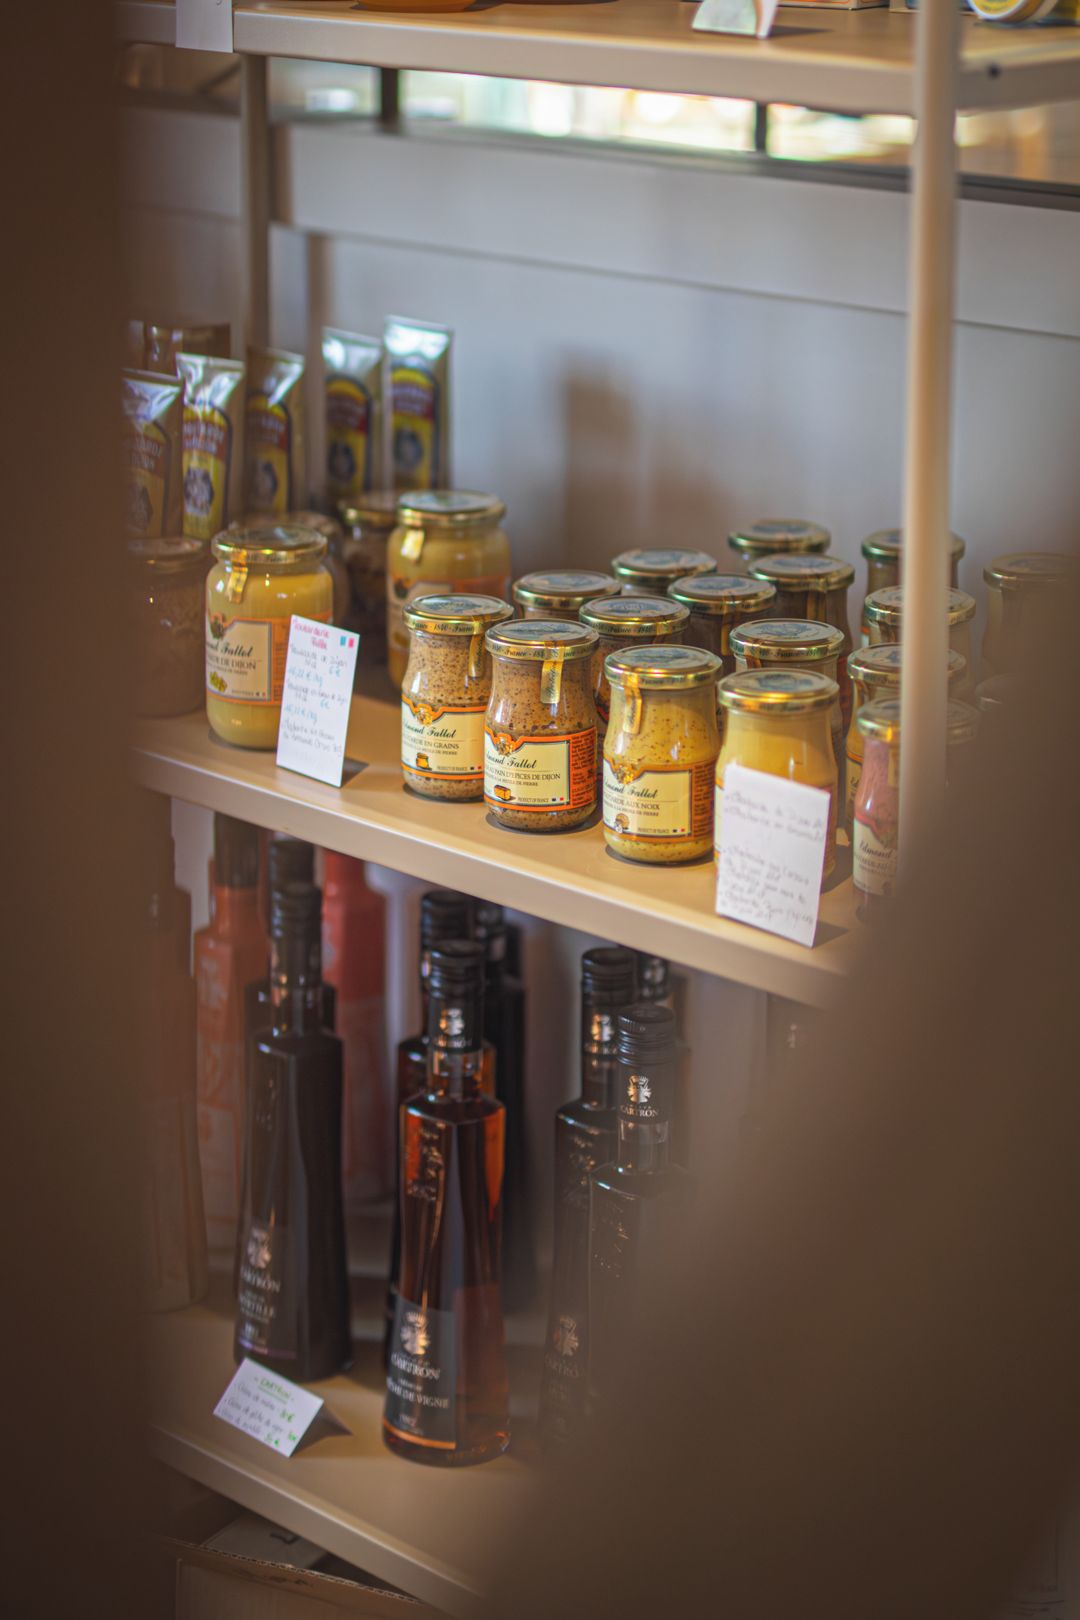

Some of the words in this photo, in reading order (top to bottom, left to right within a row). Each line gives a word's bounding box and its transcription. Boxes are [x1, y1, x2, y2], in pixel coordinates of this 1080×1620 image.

[221, 642, 254, 657] Fallot
[427, 727, 457, 738] Fallot
[434, 742, 460, 750] GRAINS
[506, 757, 537, 769] Fallot
[541, 773, 561, 781] DIJON
[628, 787, 658, 799] Fallot
